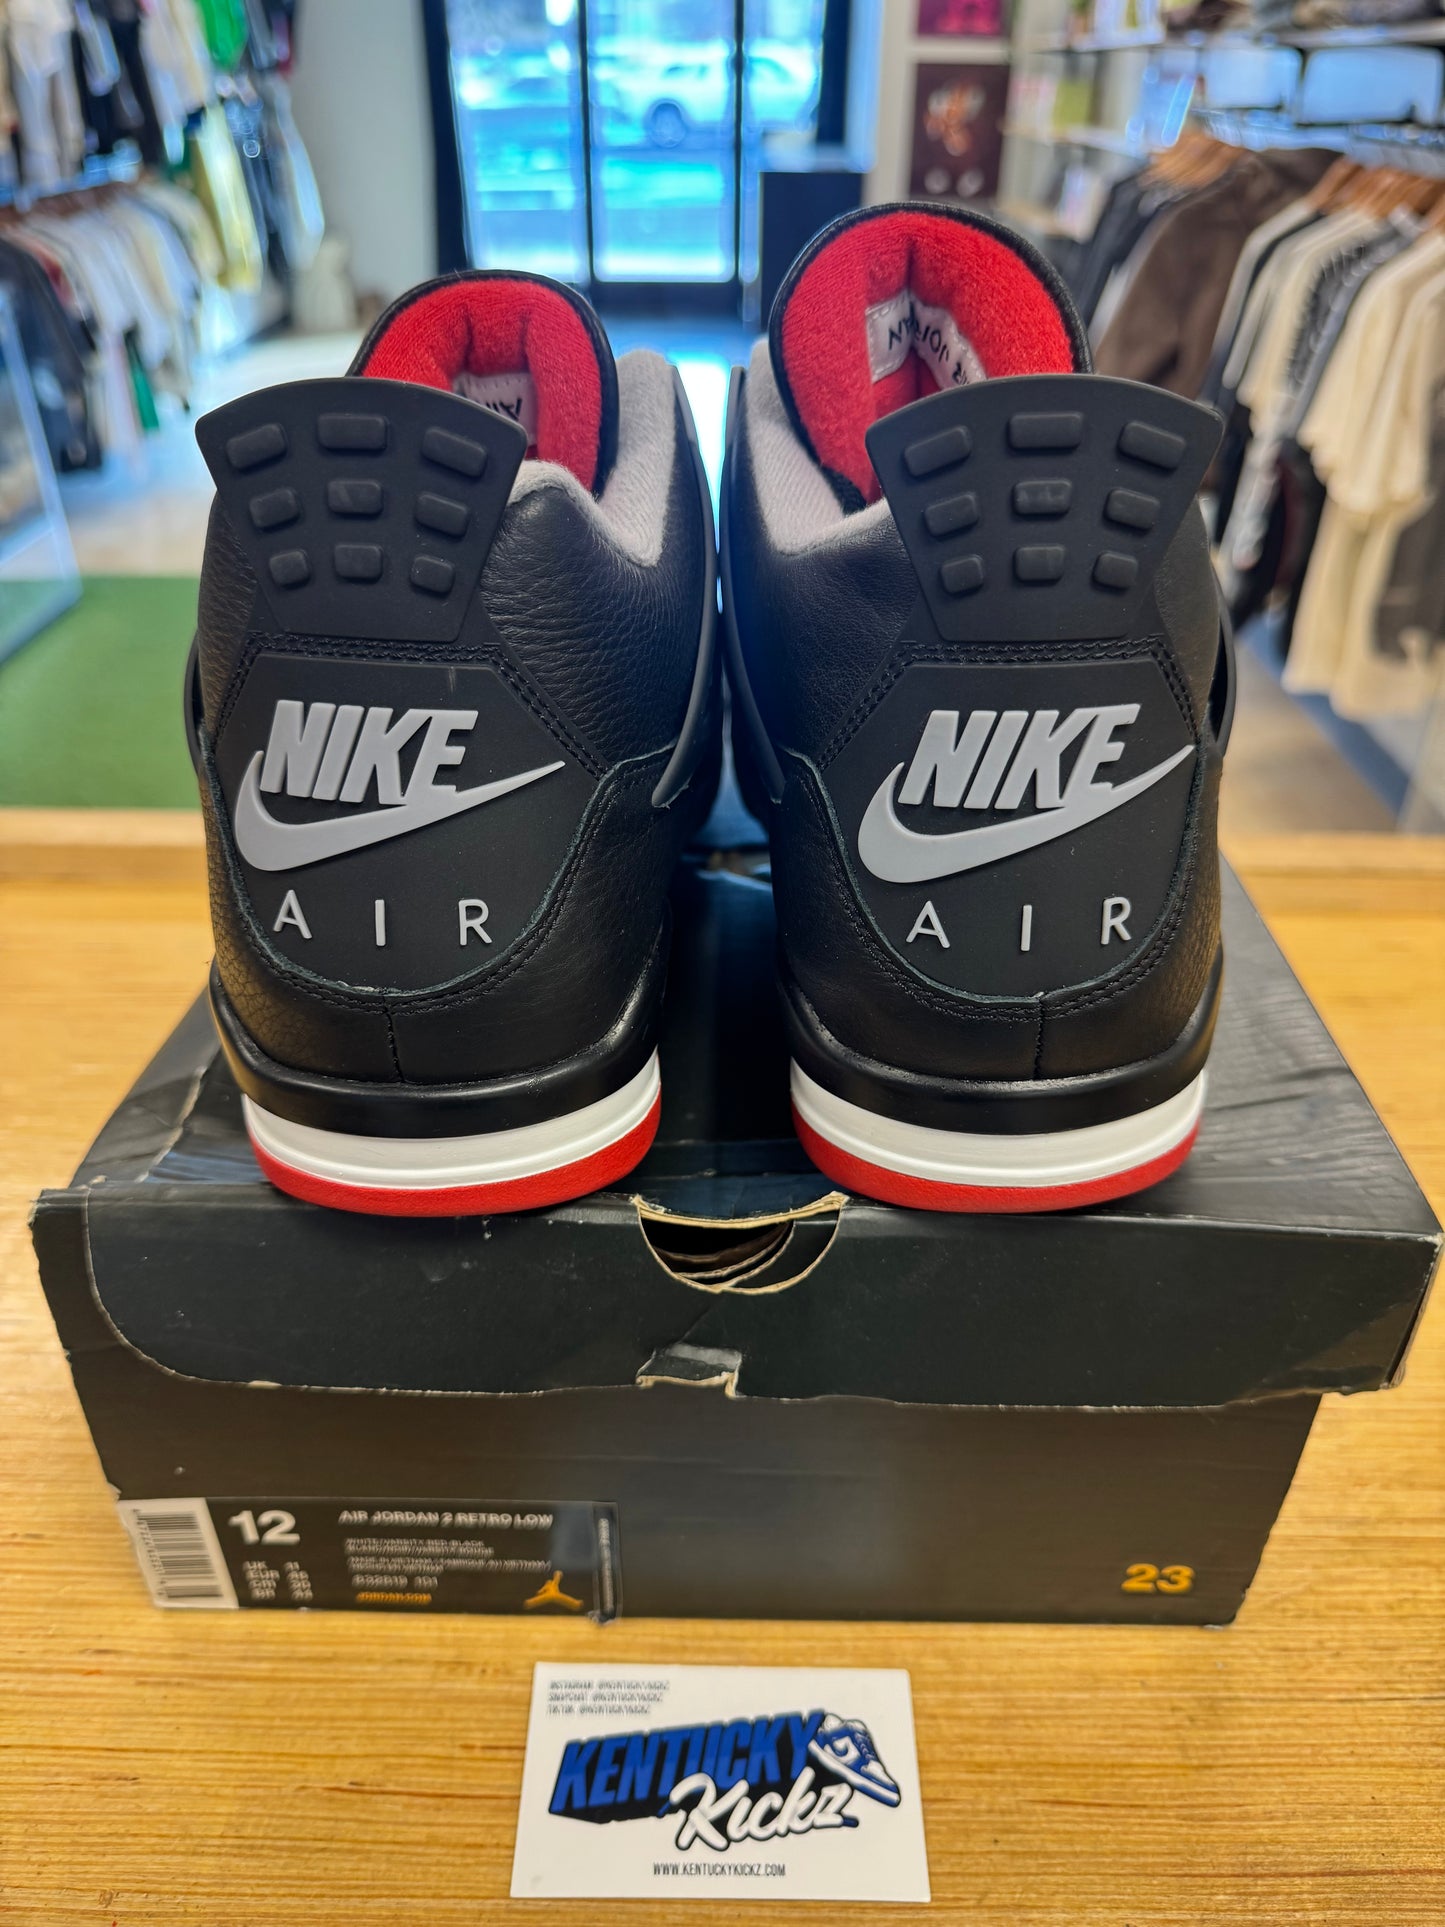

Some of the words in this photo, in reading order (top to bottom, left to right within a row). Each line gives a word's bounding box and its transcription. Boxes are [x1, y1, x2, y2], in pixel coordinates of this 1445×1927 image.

[260, 700, 478, 805] NIKE
[898, 704, 1141, 809] NIKE
[273, 889, 492, 946] AIR
[906, 896, 1131, 951] AIR
[229, 1510, 300, 1545] 12
[338, 1510, 368, 1525] AIR
[370, 1511, 439, 1526] JORDAN
[440, 1512, 453, 1527] 2
[454, 1512, 512, 1529] RETRO
[513, 1513, 553, 1530] LOW
[1121, 1563, 1196, 1593] 23
[549, 1711, 824, 1814] KENTUCKY
[668, 1766, 853, 1850] Kickz
[653, 1862, 786, 1876] WWW.KENTUCKYKICKZ.COM
